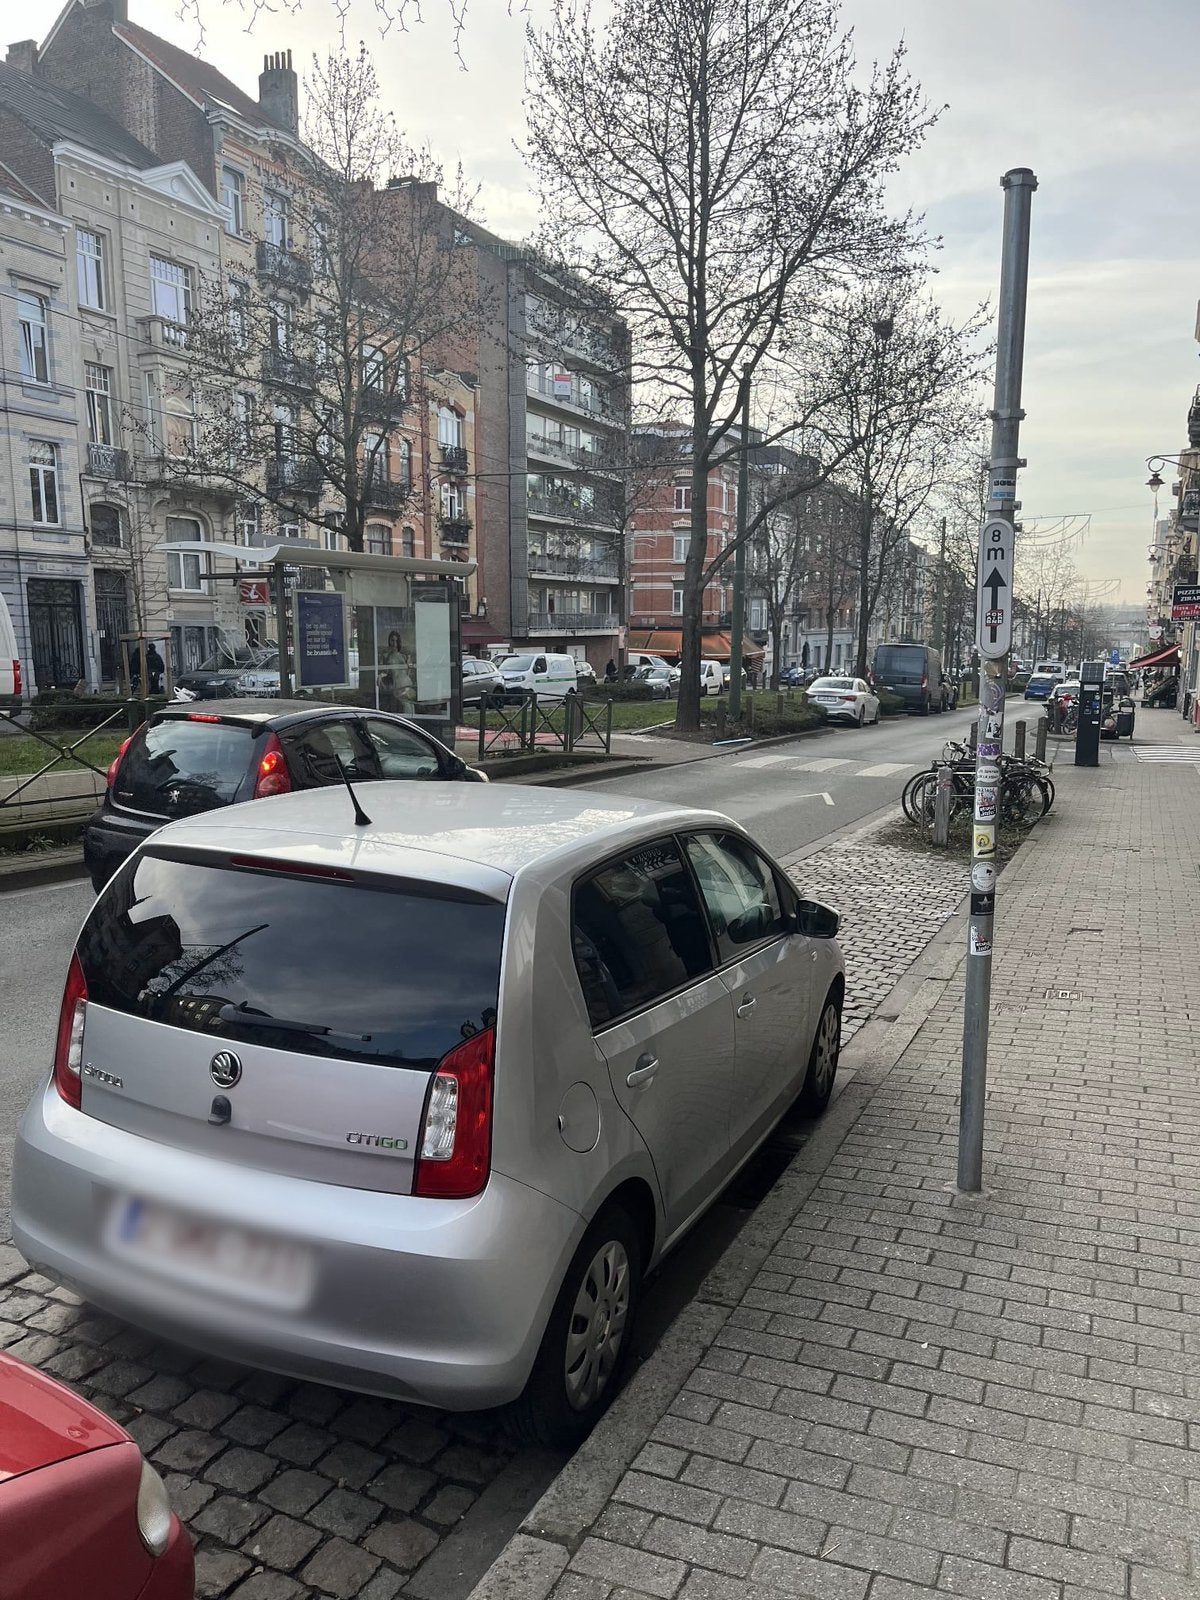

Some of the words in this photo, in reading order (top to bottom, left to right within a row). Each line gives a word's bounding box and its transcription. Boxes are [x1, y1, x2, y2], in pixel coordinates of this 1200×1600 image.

[991, 529, 1001, 543] 8
[987, 546, 1005, 561] m
[83, 1062, 124, 1089] ŠKODA
[346, 1131, 408, 1151] CITIGO
